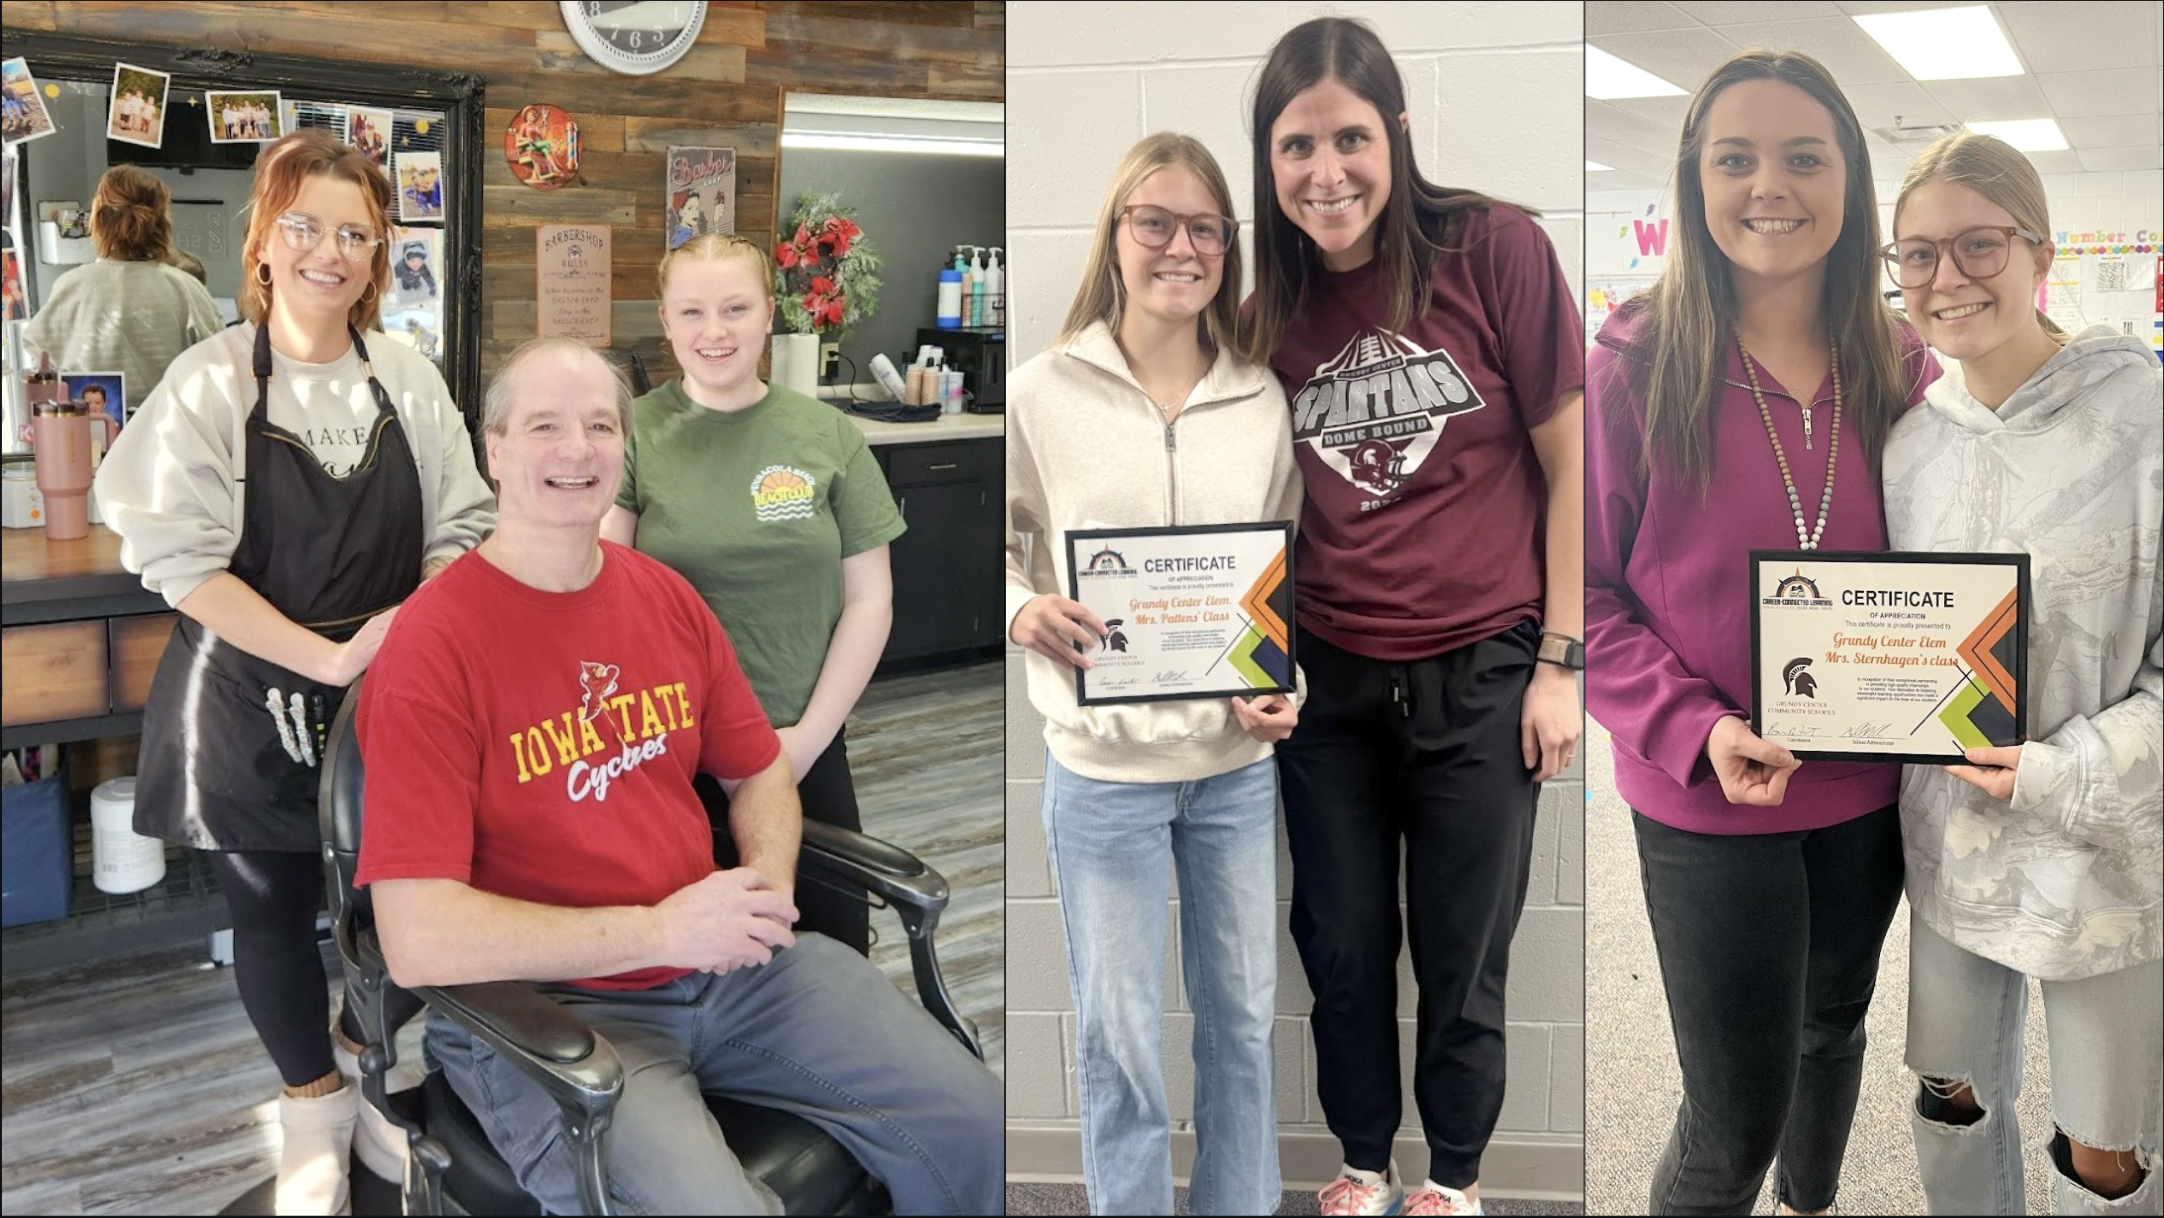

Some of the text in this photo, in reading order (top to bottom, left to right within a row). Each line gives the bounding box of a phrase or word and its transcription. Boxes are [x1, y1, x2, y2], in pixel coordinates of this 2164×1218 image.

[590, 1, 600, 17] 8
[610, 23, 620, 41] 7
[629, 31, 641, 48] 6
[653, 25, 664, 42] 5
[673, 150, 732, 187] Barber
[545, 229, 603, 252] BARBERSHOP
[1633, 218, 1669, 256] W
[2056, 230, 2126, 244] Number
[1294, 361, 1469, 432] SPARTANS
[1324, 418, 1428, 445] DOME BOUND
[788, 485, 814, 500] CLUB
[1144, 555, 1236, 573] CERTIFICATE
[1129, 595, 1231, 612] Grundy Center Elem.
[1842, 589, 1954, 608] CERTIFICATE
[1135, 614, 1157, 625] Mrs.
[1203, 610, 1229, 622] Class
[1845, 620, 1857, 628] This
[1858, 620, 1886, 628] certificate
[1893, 621, 1915, 630] proudly
[1915, 622, 1944, 630] presented
[1945, 622, 1951, 630] to
[1879, 612, 1926, 620] APPRECIATION
[1833, 631, 1947, 650] Grundy Center Elem
[1825, 651, 1959, 668] Mrs. Sternhagen's class
[509, 682, 695, 783] IOWA TATE
[567, 732, 667, 802] Cyclnes
